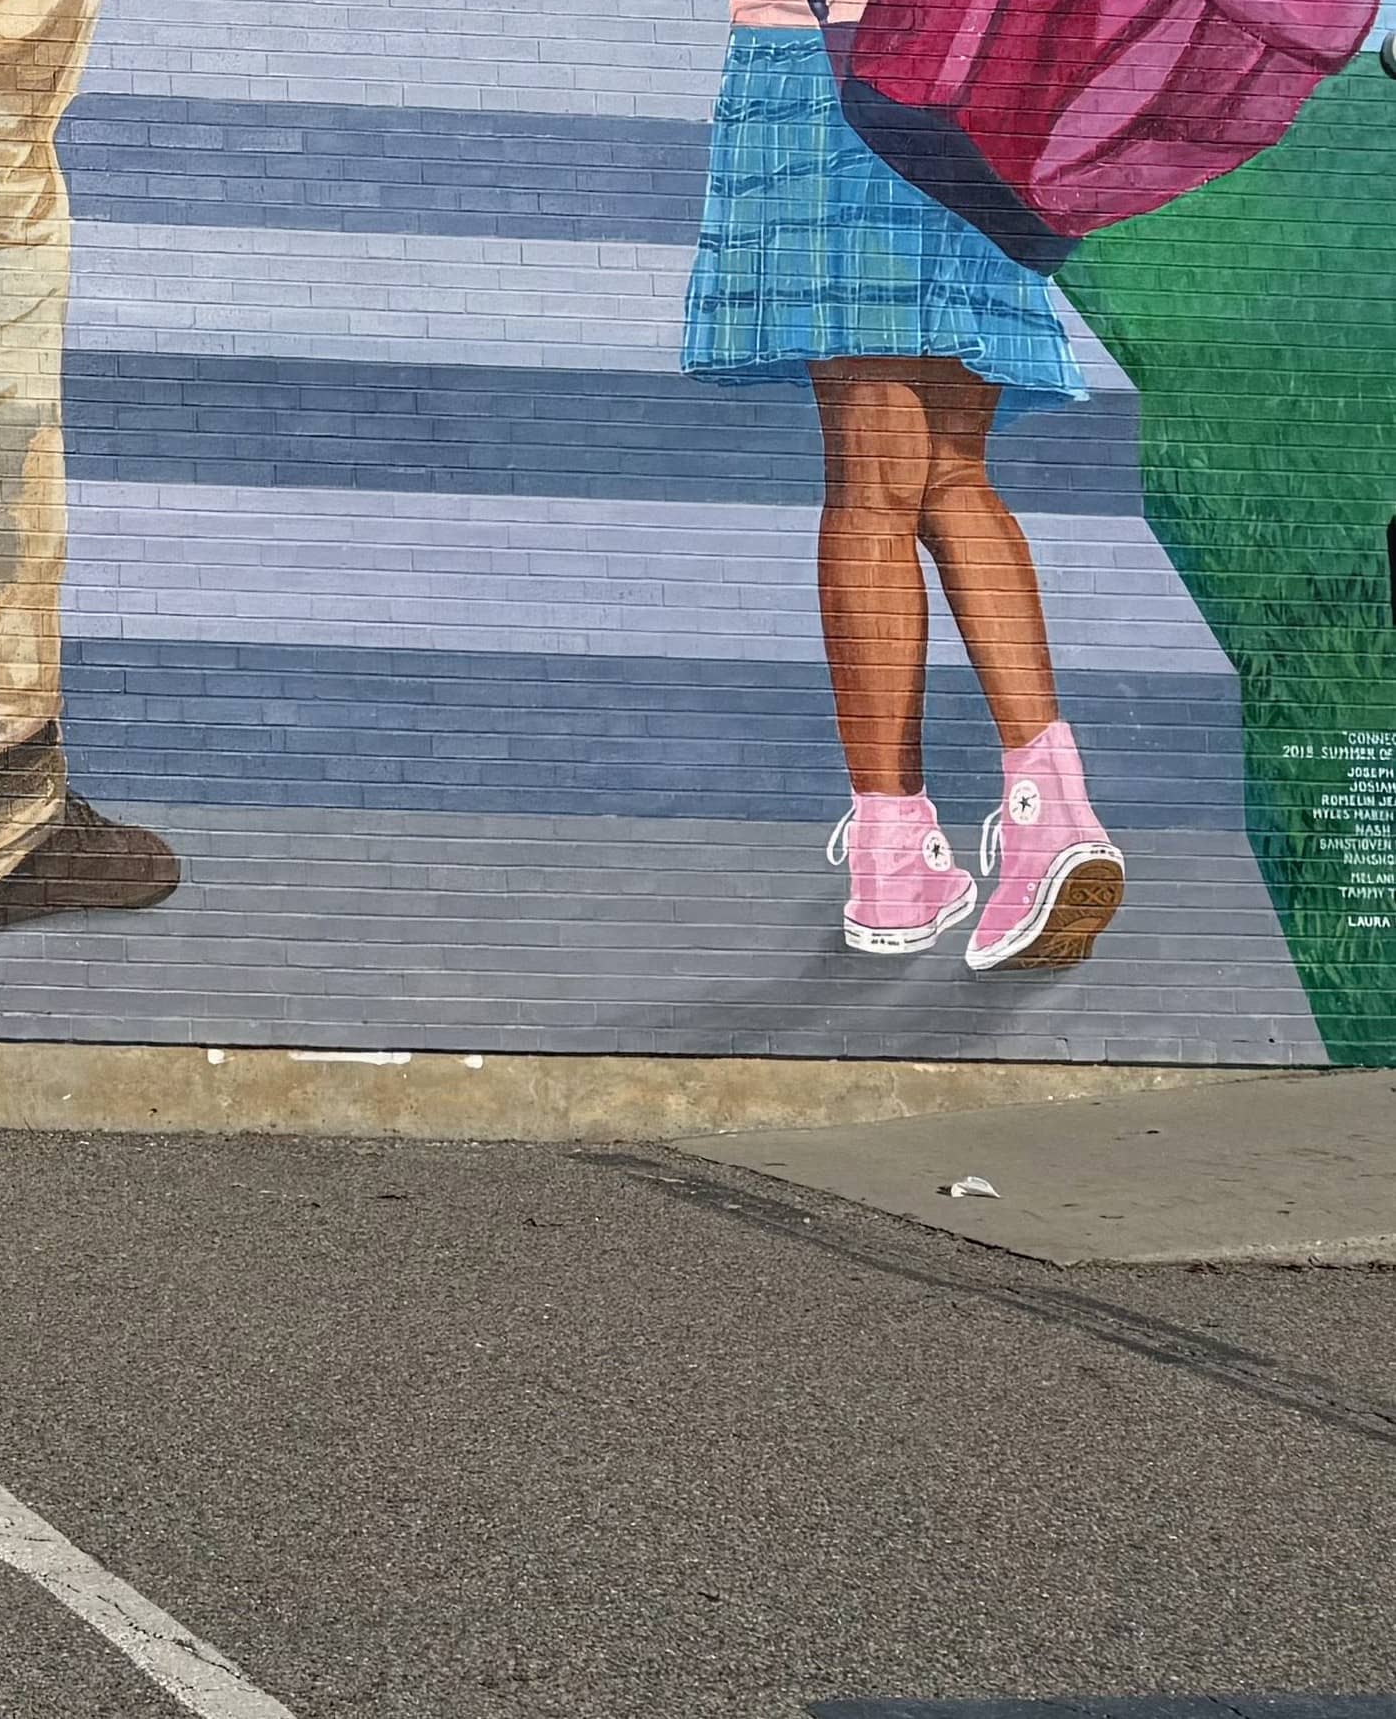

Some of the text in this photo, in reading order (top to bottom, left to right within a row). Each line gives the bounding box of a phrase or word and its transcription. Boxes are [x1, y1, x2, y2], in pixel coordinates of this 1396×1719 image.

[1321, 746, 1376, 760] SUMMER
[1347, 767, 1394, 778] JOSEPH
[1312, 808, 1351, 820] MYLES
[1337, 886, 1385, 899] TAMMY
[1348, 916, 1391, 928] LAURA
